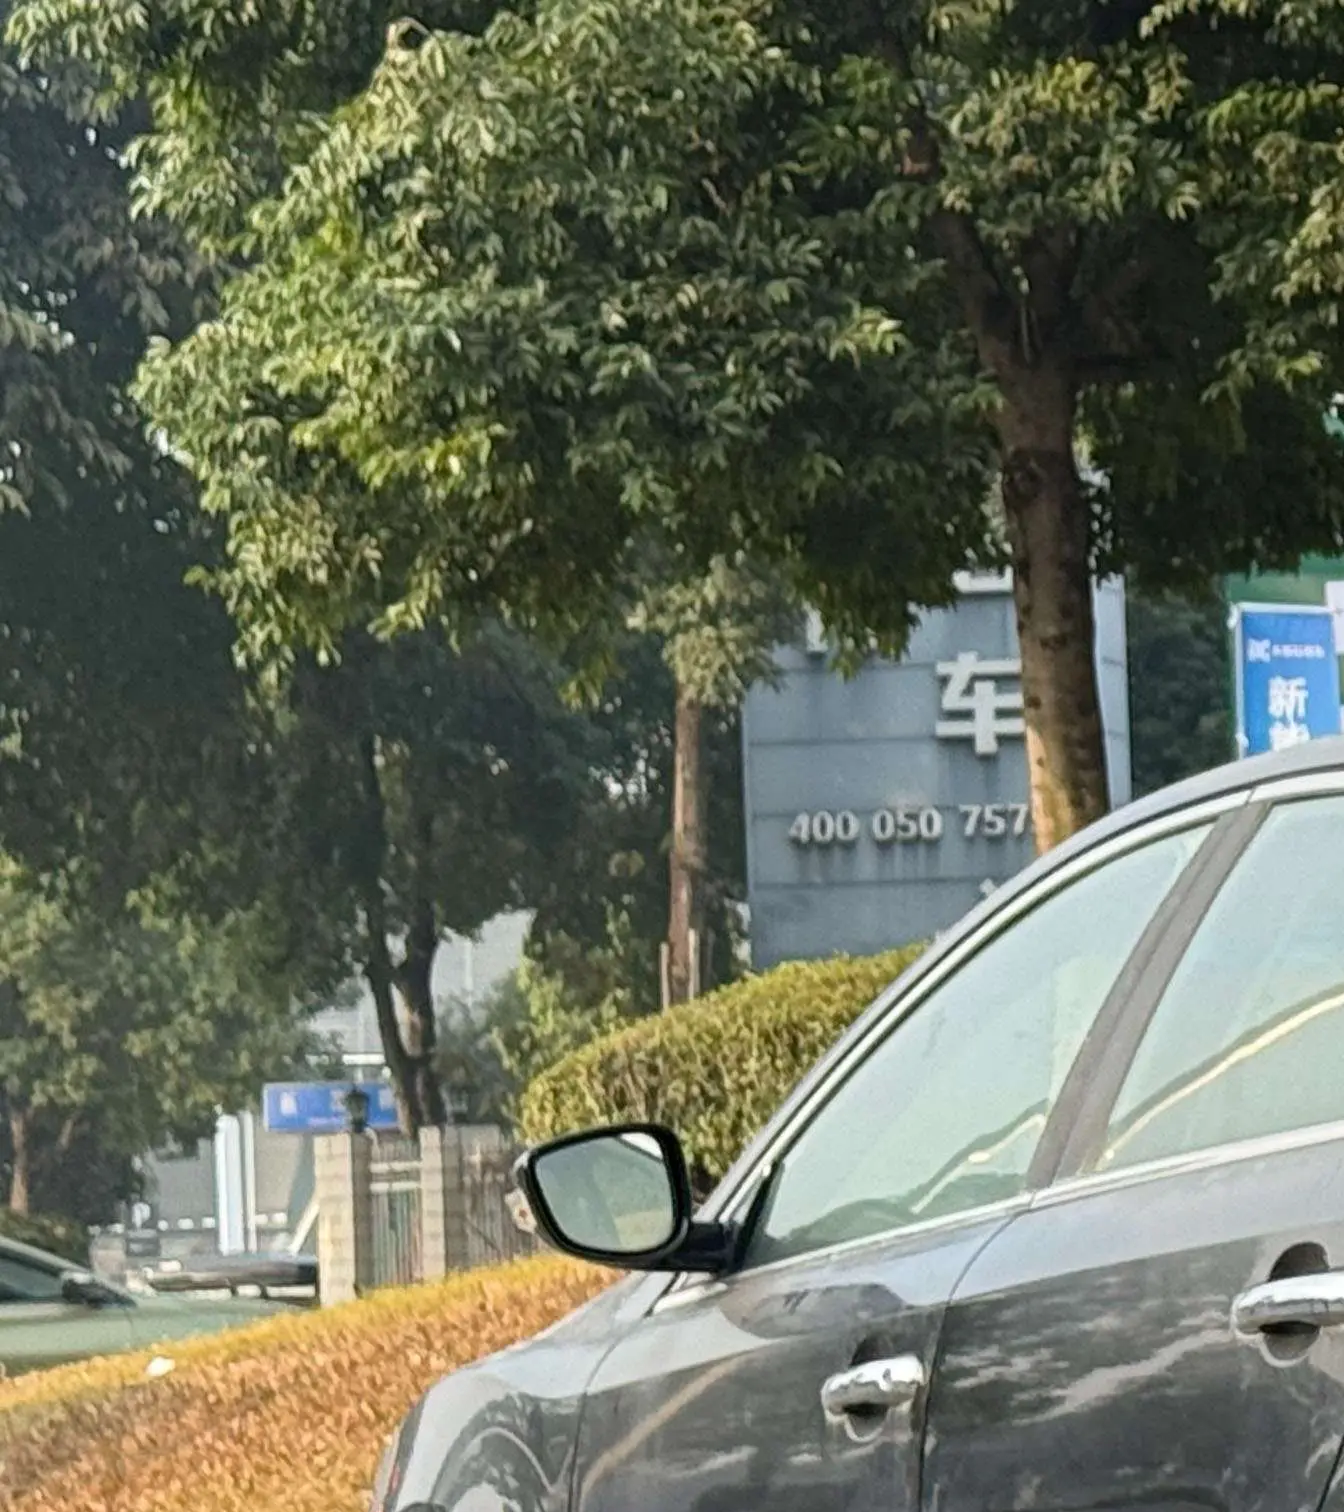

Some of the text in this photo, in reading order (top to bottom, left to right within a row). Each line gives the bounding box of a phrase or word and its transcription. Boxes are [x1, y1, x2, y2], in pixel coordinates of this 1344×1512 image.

[788, 802, 1034, 844] 400 050 757
